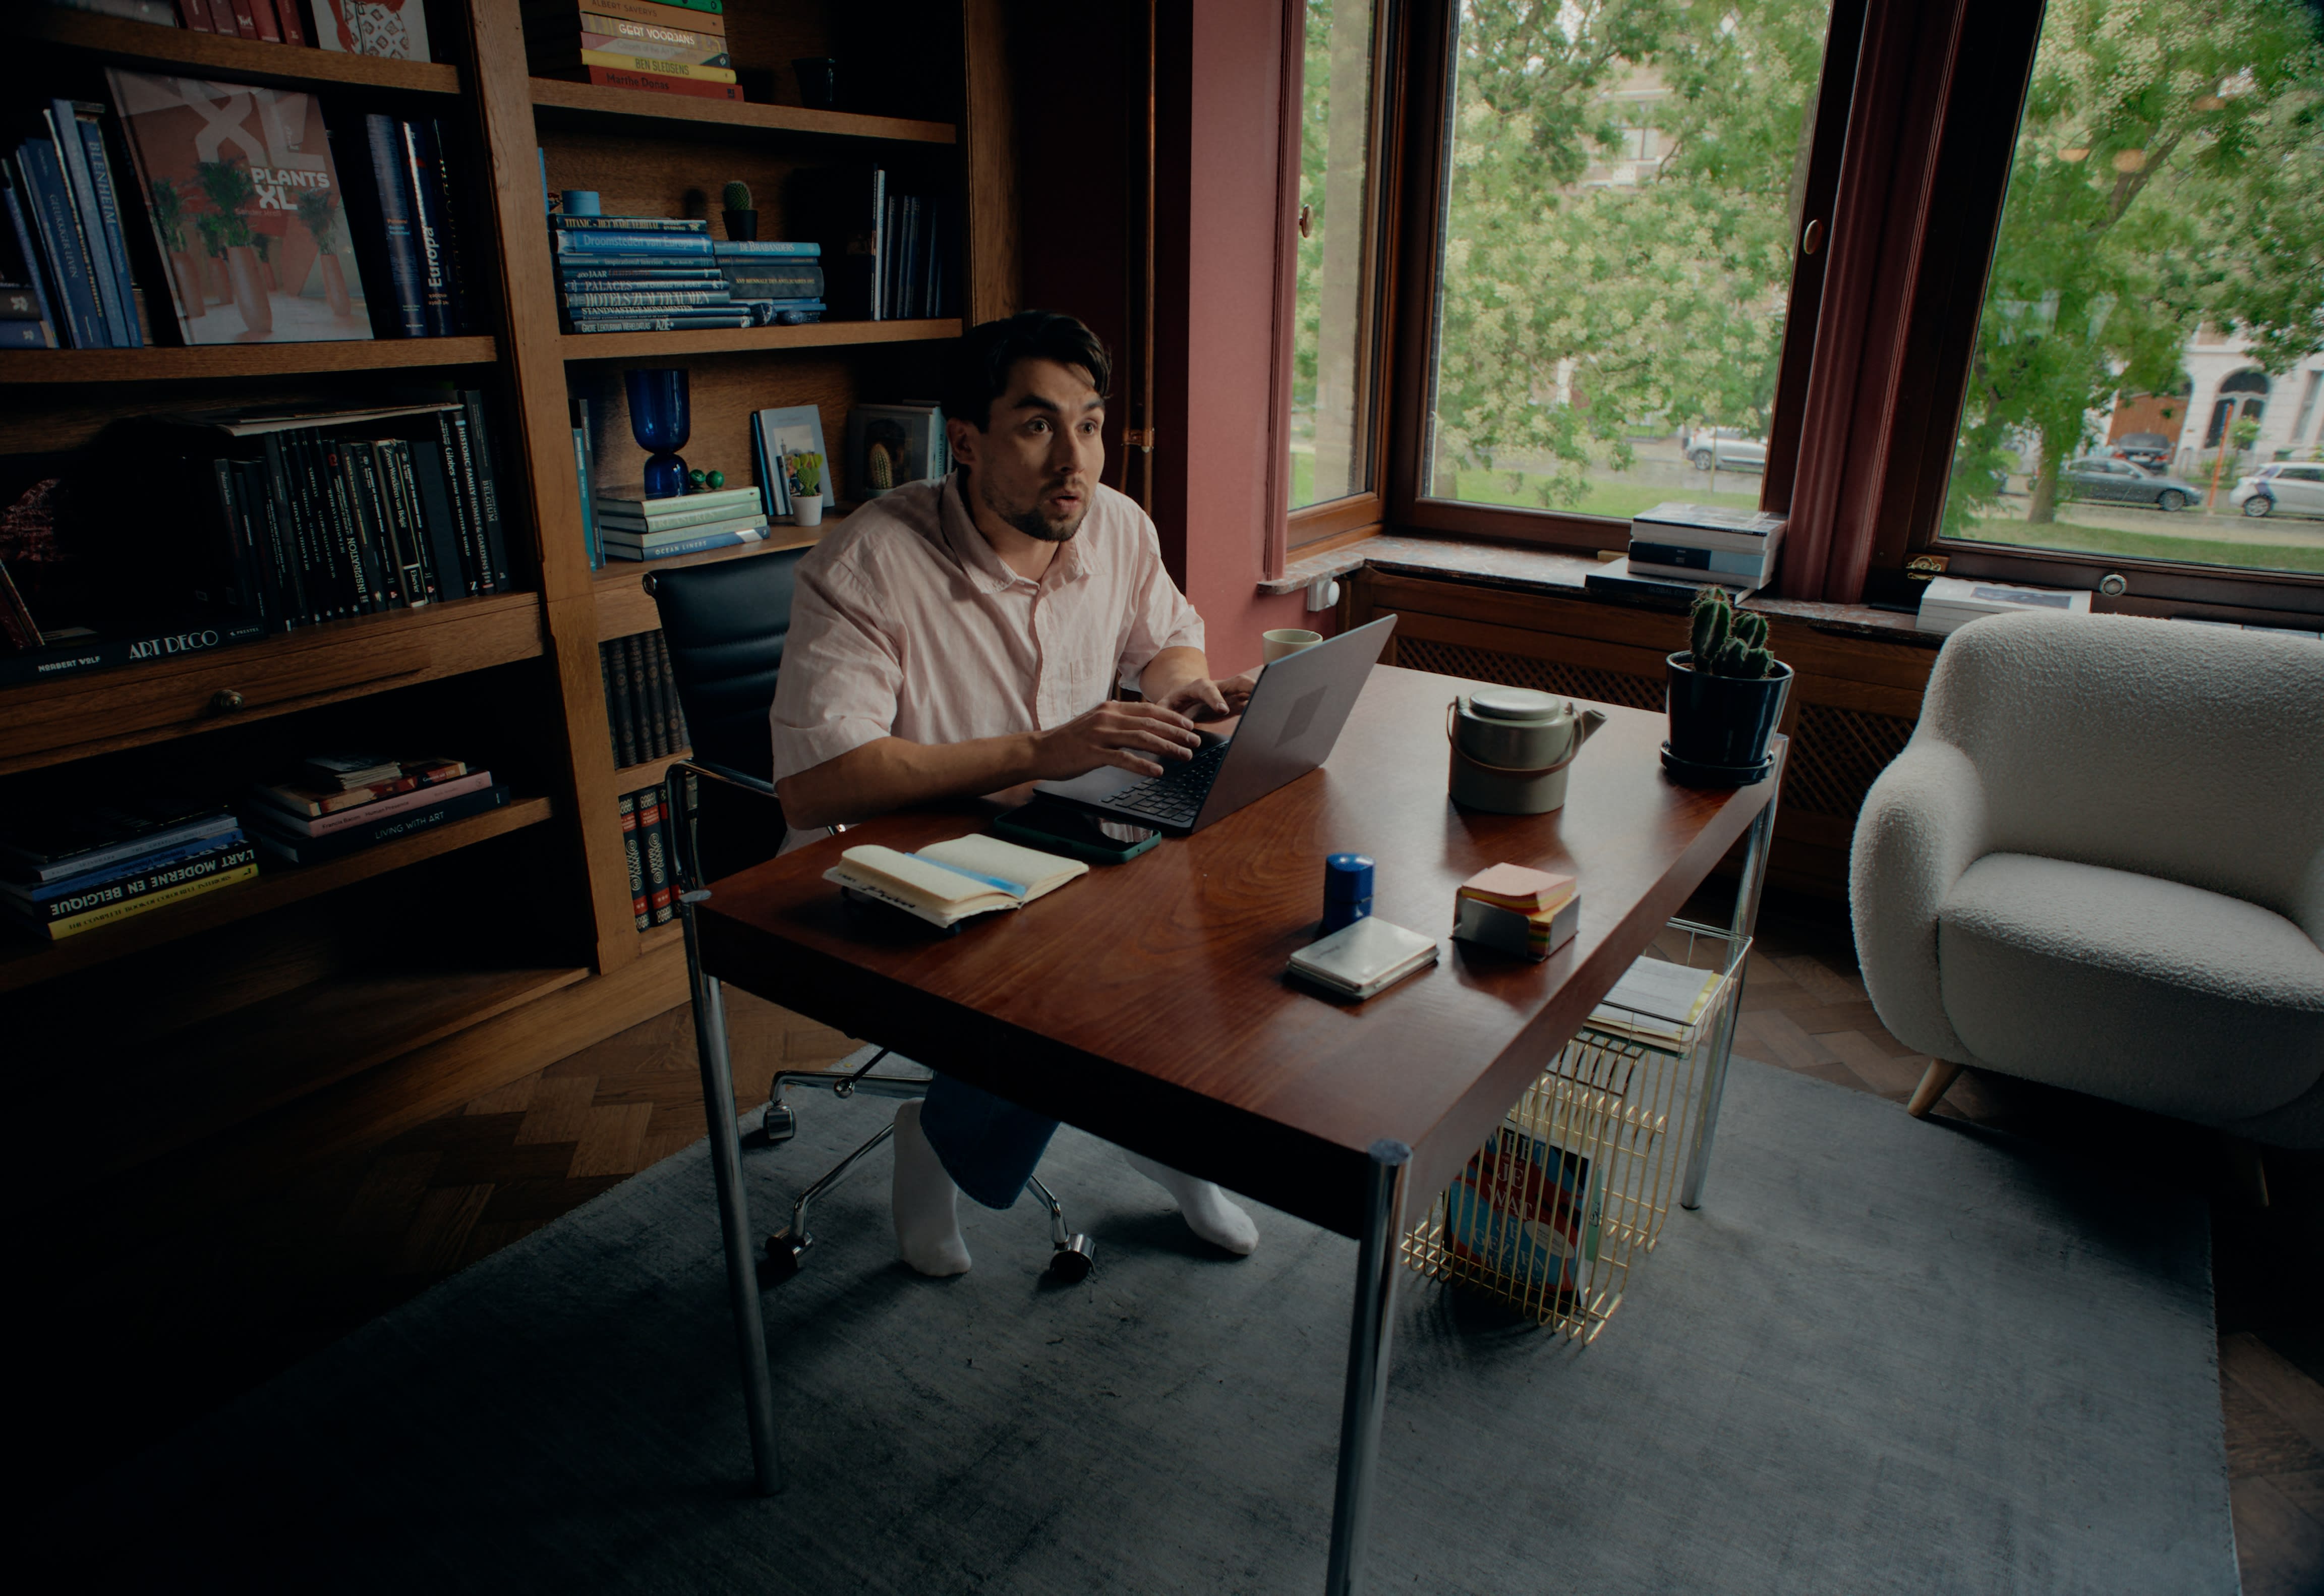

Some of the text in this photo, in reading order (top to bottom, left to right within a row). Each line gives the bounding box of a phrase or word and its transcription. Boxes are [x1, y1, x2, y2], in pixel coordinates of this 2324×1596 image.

[592, 0, 658, 17] ALBERT SAVERYS
[619, 23, 695, 45] GERT VOORJANS
[635, 58, 690, 75] BEN SLEDSENS
[606, 73, 670, 90] Marthe Donas
[87, 139, 119, 225] BLENHEIM
[251, 167, 330, 188] PLANTS
[255, 185, 299, 210] XL
[565, 218, 592, 228] TITANIC
[583, 234, 644, 248] Droomsteden
[645, 239, 662, 247] van
[739, 244, 748, 252] DE
[427, 225, 443, 288] Europa
[589, 270, 607, 278] JAAR
[585, 280, 633, 292] PALACES
[585, 292, 630, 307] HOTELS
[383, 447, 395, 468] Zeven
[387, 467, 402, 498] Wonderen
[394, 497, 403, 510] van
[444, 445, 456, 476] Globes
[460, 534, 472, 555] WORLD
[458, 427, 491, 572] HISTORIC FAMILY HOMES & GARDENS
[482, 480, 495, 523] BELGIUM
[655, 540, 707, 555] OCEAN LINERS
[346, 537, 367, 593] INSPIRATION
[37, 658, 77, 673] NORBERT
[127, 639, 162, 660] ART
[162, 627, 219, 654] DECO
[322, 819, 342, 829] Francis
[343, 814, 361, 823] Bacon
[374, 811, 446, 840] LIVING WITH ART
[48, 848, 255, 917] L'ART MODERNE EN BELGIQUE
[68, 921, 81, 930] THE
[83, 909, 122, 925] COMPLETE
[125, 901, 147, 913] BOOK
[1497, 1161, 1525, 1190] JE
